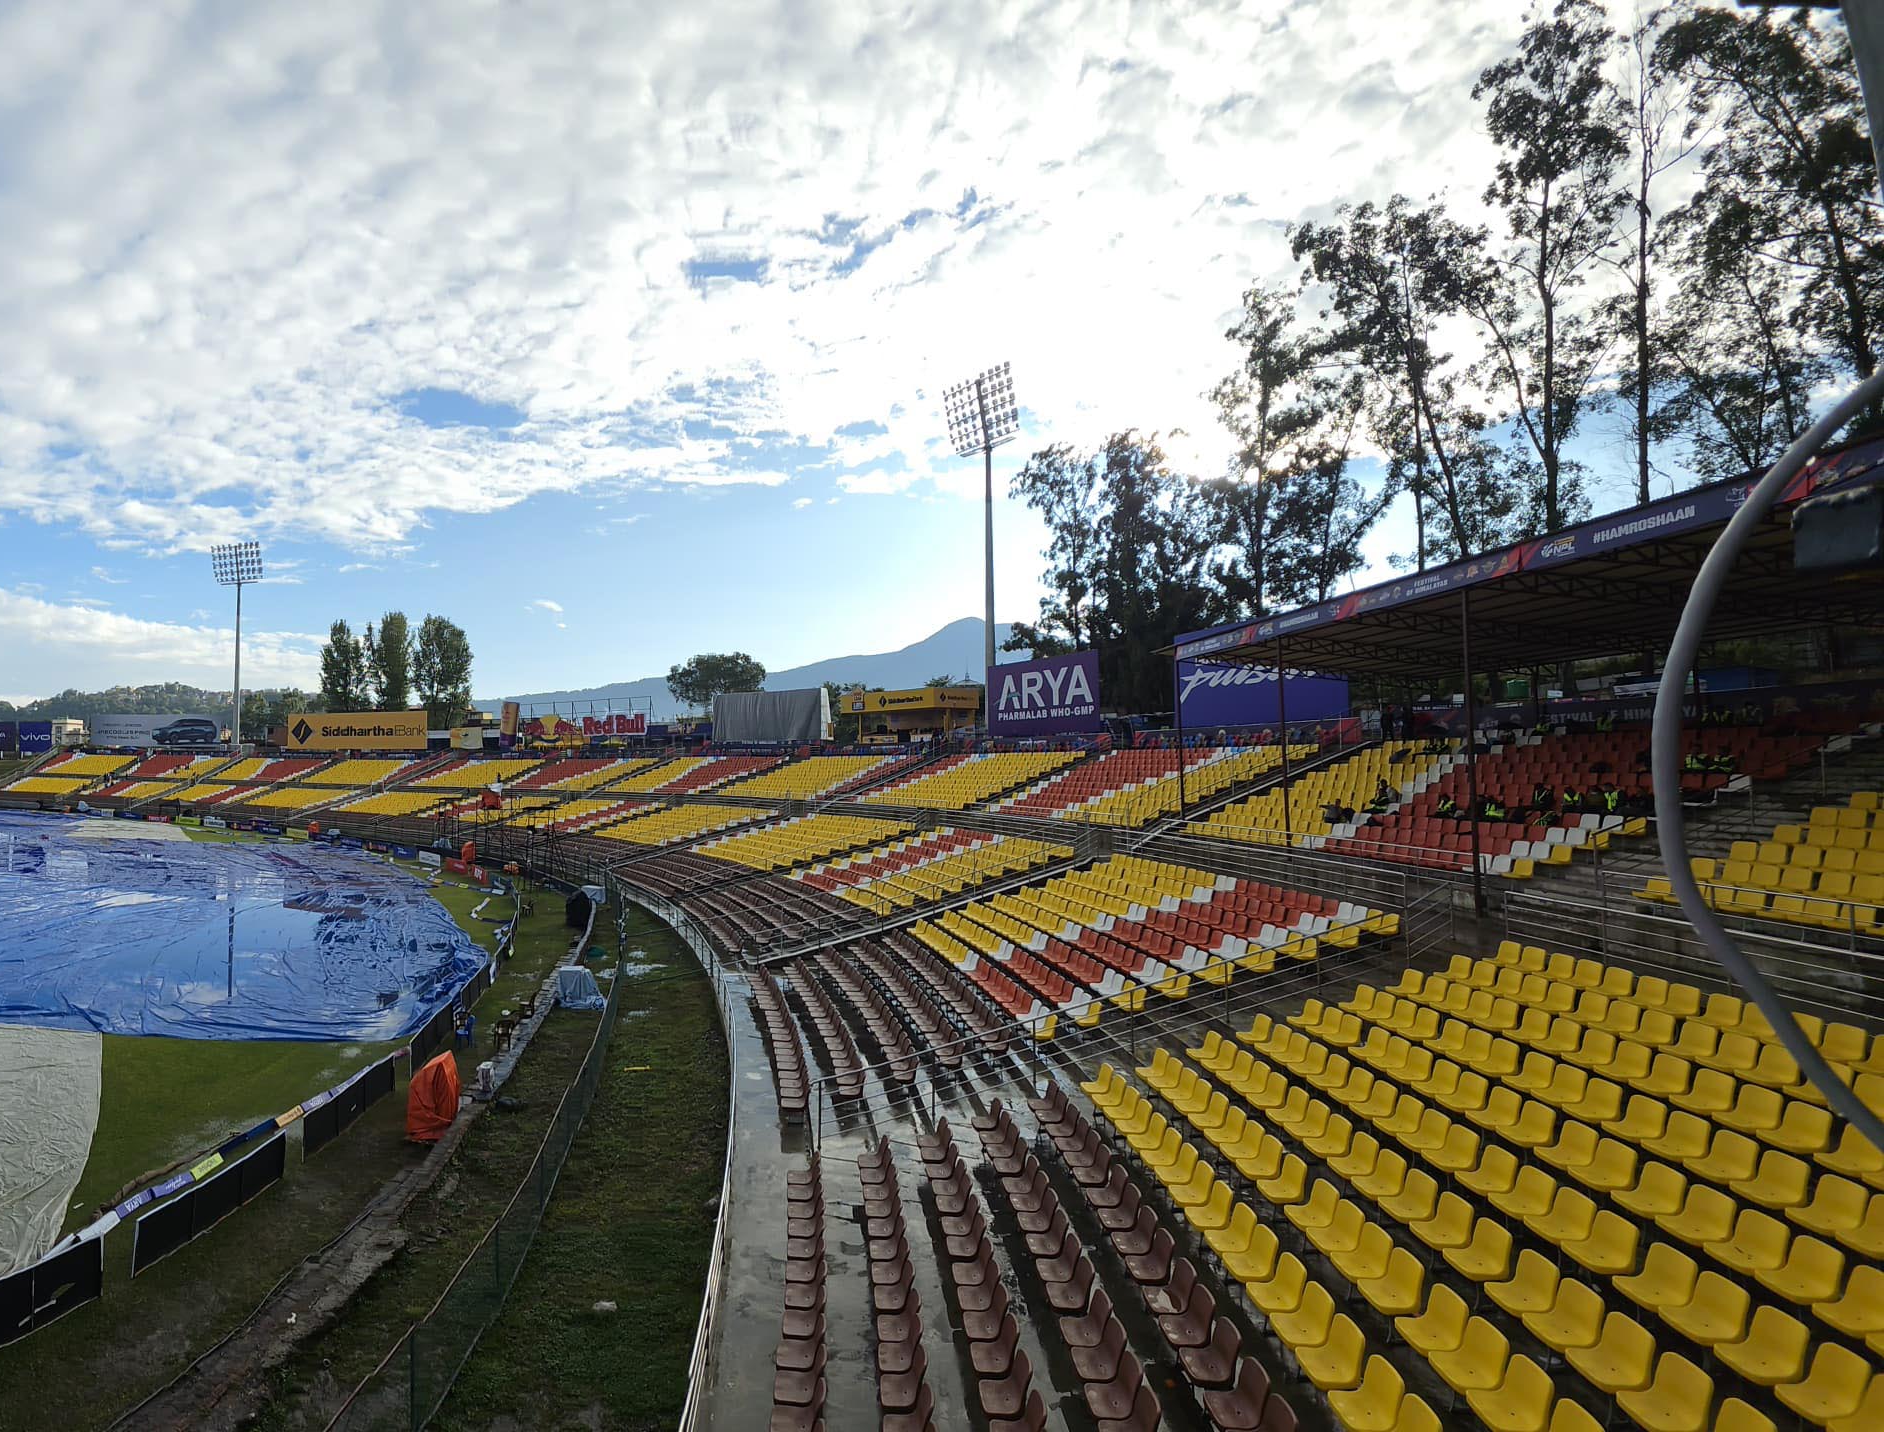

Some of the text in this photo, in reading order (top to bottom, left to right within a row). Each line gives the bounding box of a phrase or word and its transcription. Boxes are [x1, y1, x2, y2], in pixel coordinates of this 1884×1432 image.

[1593, 505, 1696, 544] #HAMROSHAAN
[998, 665, 1094, 711] ARYA
[583, 713, 647, 736] Red Bull
[998, 705, 1095, 721] PHARMALAB WHO-GMP
[20, 732, 51, 741] vivo
